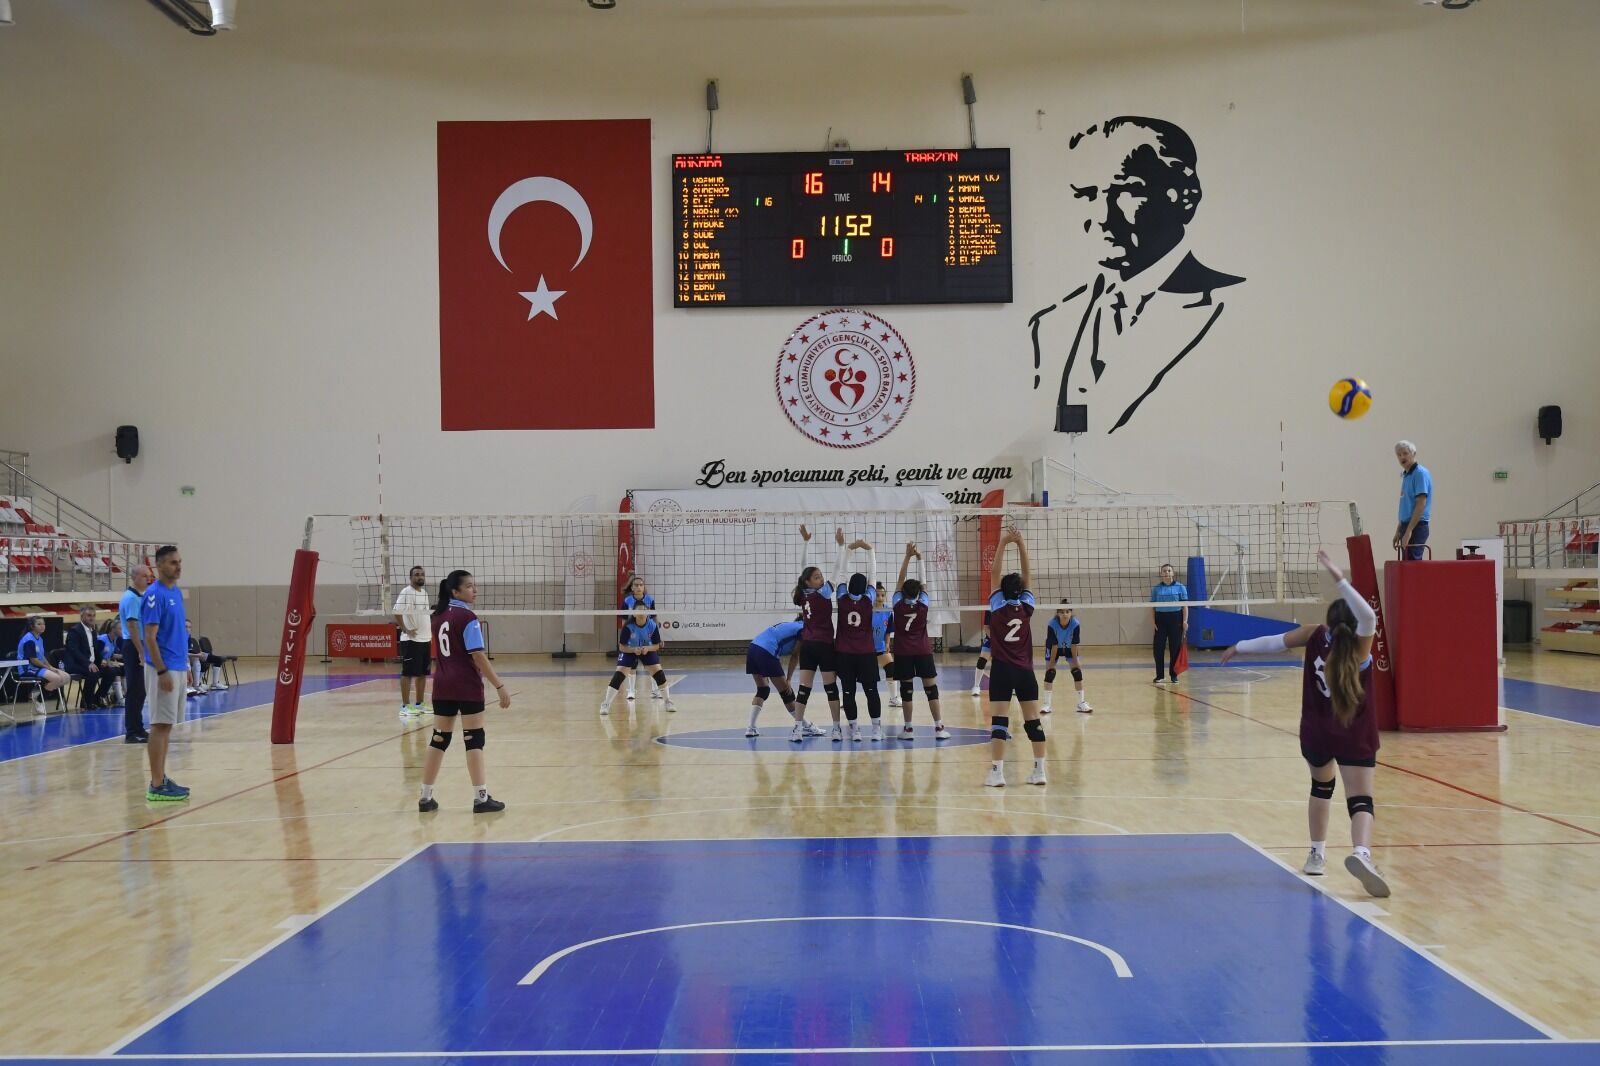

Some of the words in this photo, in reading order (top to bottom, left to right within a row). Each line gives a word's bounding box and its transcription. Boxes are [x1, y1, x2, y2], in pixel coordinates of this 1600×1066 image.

[805, 173, 823, 194] 16
[872, 172, 891, 192] 14
[756, 197, 759, 206] 1
[764, 197, 773, 207] 16
[834, 193, 851, 202] TIME
[914, 195, 923, 204] 14
[933, 194, 937, 203] 1
[682, 219, 688, 229] 7
[792, 240, 804, 258] 0
[844, 239, 849, 255] 1
[881, 238, 893, 257] 0
[832, 334, 869, 347] GENÇLİK
[870, 344, 881, 357] VE
[801, 338, 831, 392] CUMHURİYETİ
[878, 355, 890, 380] SPOR
[804, 393, 835, 421] TÜRKİYE
[858, 381, 890, 421] BAKANLIĞI
[695, 459, 747, 489] Ben
[751, 467, 844, 487] sporcunun
[846, 465, 890, 487] zeki,
[896, 463, 943, 487] çevik
[946, 467, 967, 481] ve
[972, 465, 1013, 484] aynı
[847, 611, 862, 628] 9
[904, 613, 918, 632] 7
[438, 621, 451, 657] 6
[1004, 618, 1023, 642] 2
[284, 629, 297, 665] TVF
